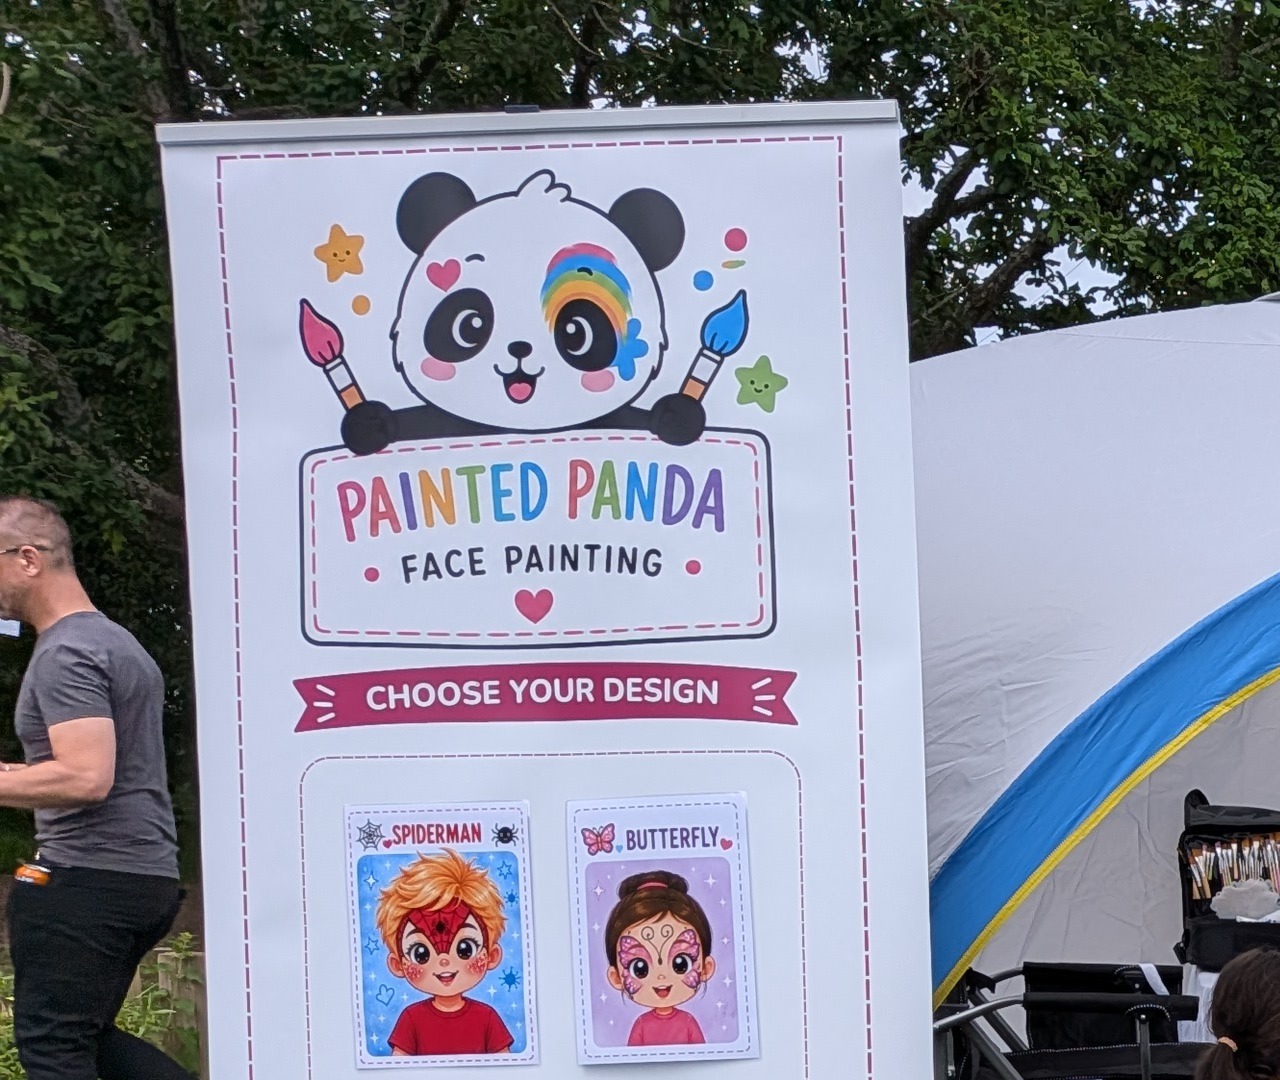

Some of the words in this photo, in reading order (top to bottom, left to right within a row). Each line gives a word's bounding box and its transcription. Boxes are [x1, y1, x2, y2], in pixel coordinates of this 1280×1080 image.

[337, 461, 548, 542] PAINTED
[567, 459, 725, 533] PANDA
[400, 546, 487, 584] FACE
[505, 544, 663, 577] PAINTING
[365, 680, 500, 711] CHOOSE
[508, 678, 594, 705] YOUR
[604, 678, 719, 705] DESIGN
[391, 823, 482, 846] SPIDERMAN
[625, 826, 720, 851] BUTTERFLY
